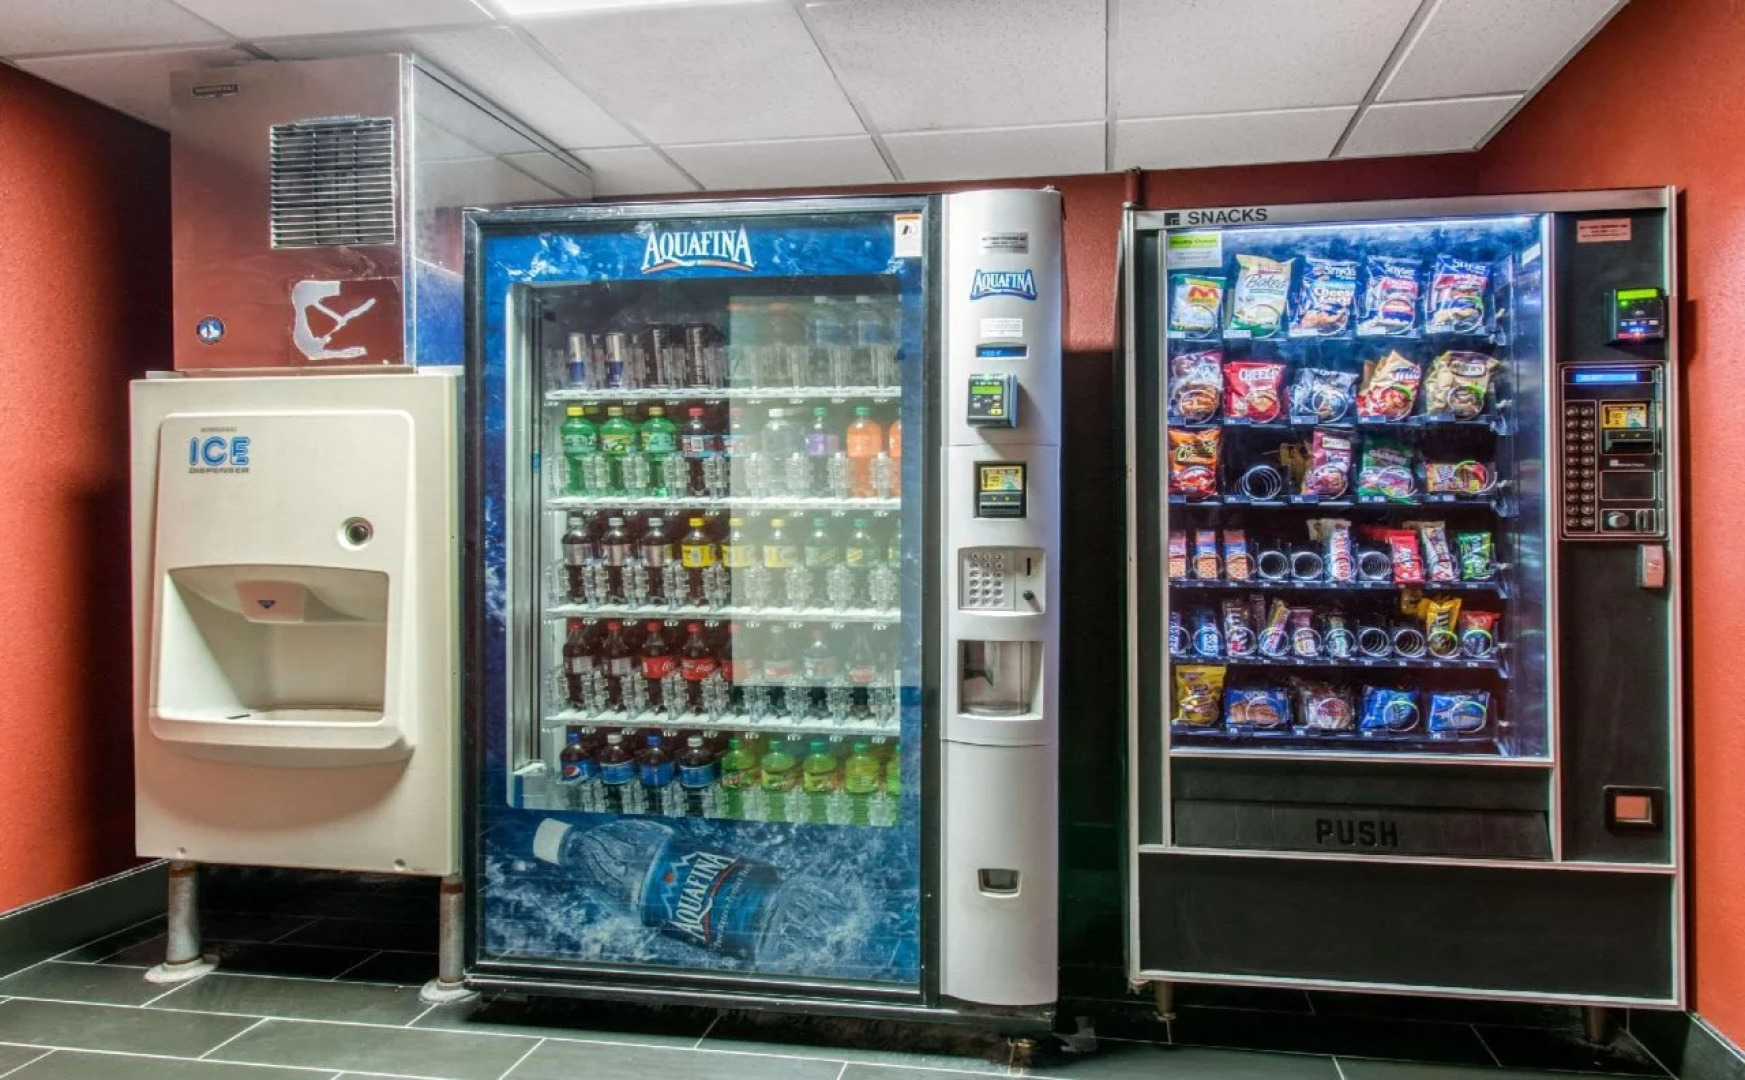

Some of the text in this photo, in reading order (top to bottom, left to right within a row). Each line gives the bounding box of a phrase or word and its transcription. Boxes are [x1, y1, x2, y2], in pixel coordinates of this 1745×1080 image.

[1188, 208, 1268, 225] SNACKS
[640, 223, 757, 272] AQUAFINA
[971, 269, 1036, 298] AQUAFINA
[189, 436, 250, 466] ICE
[1316, 818, 1398, 847] PUSH
[668, 850, 738, 942] AQUAFINA
